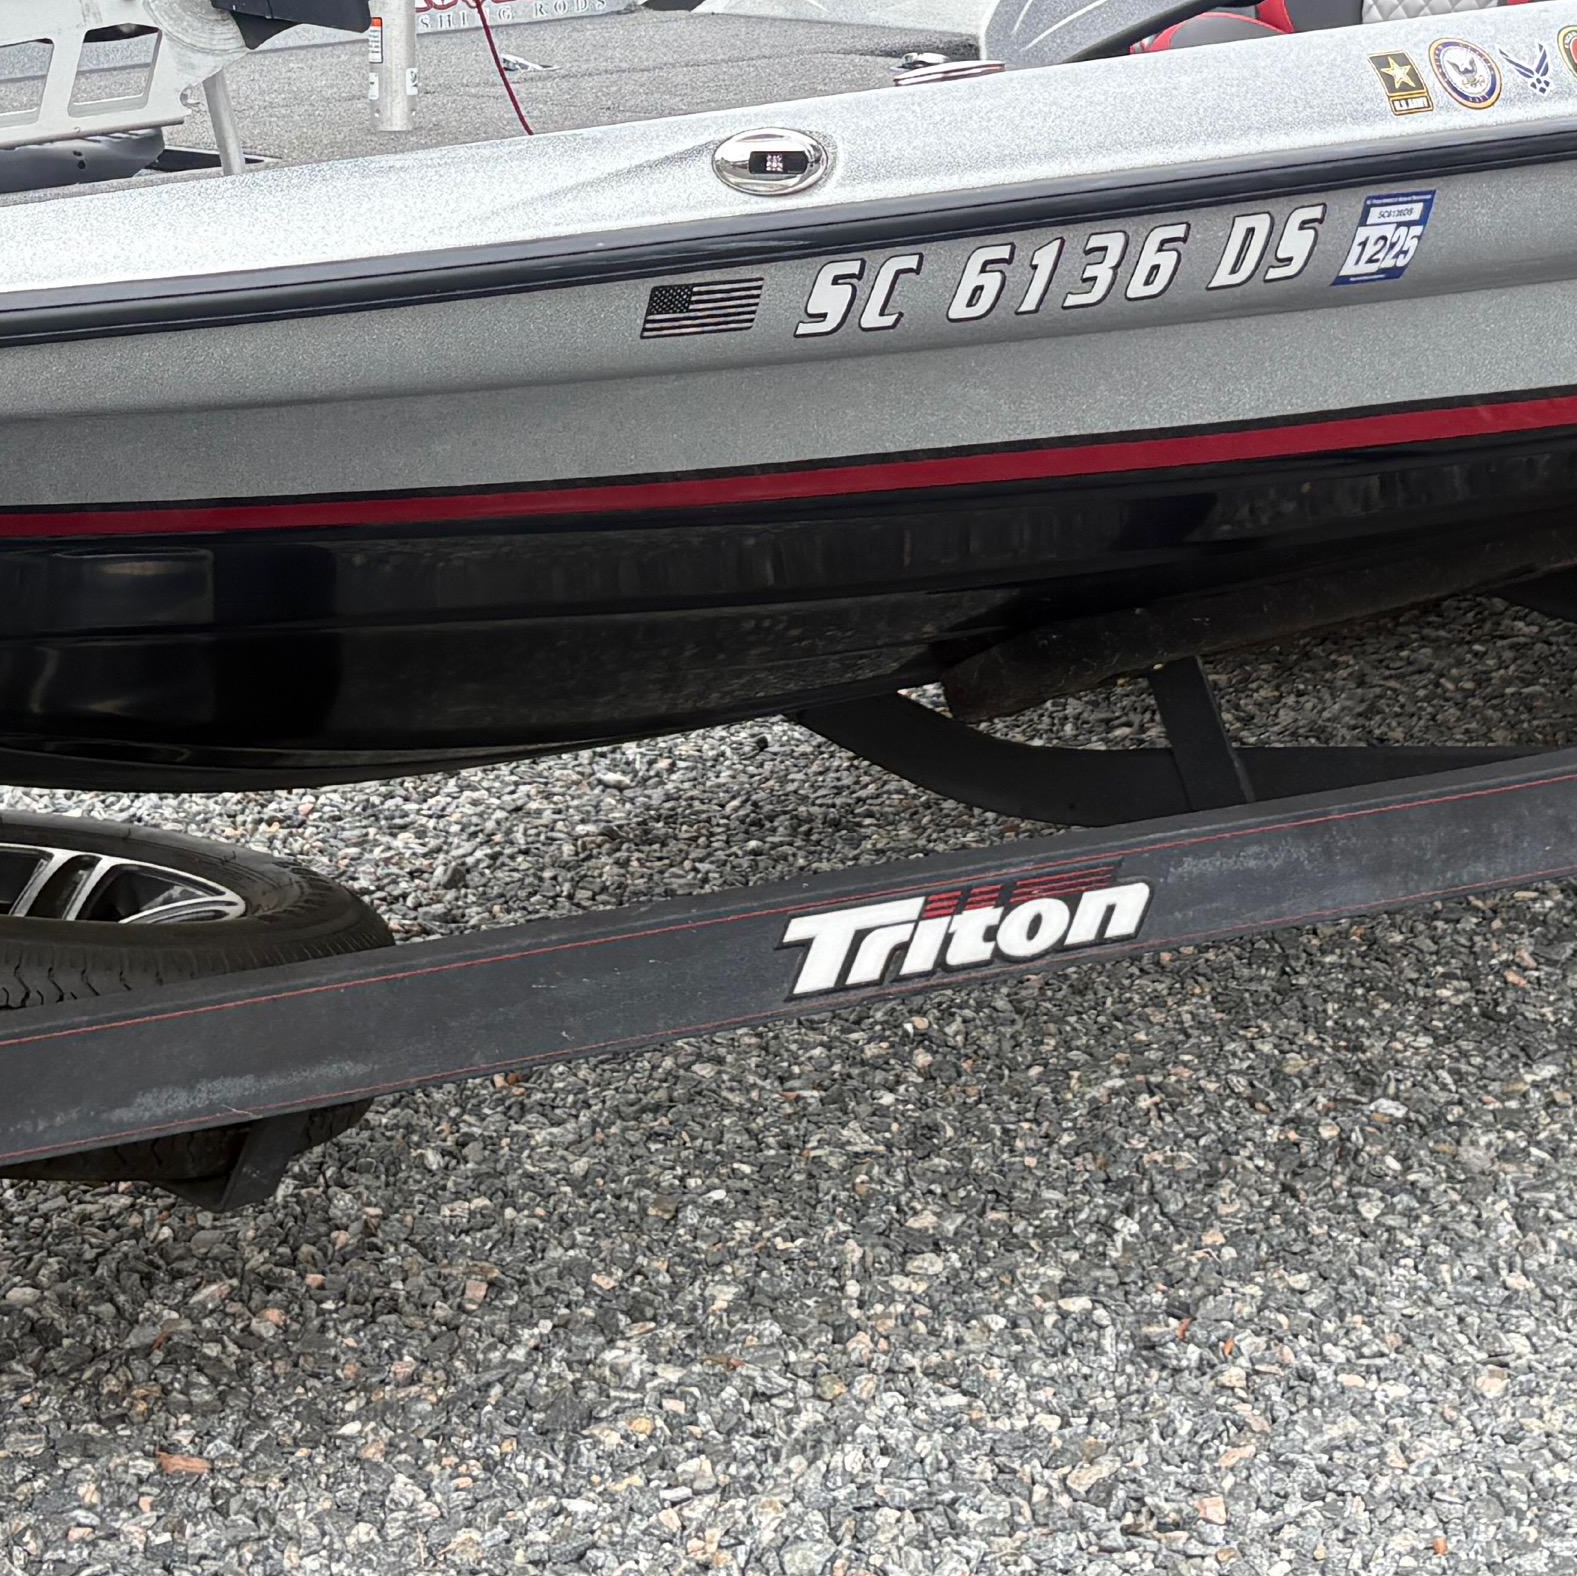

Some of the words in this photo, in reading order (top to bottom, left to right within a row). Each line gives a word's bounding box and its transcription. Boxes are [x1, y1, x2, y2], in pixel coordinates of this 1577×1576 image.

[794, 252, 924, 338] SC
[947, 222, 1191, 323] 6136
[1206, 202, 1328, 291] DS
[1354, 235, 1389, 266] 12
[780, 877, 1153, 998] Triton
